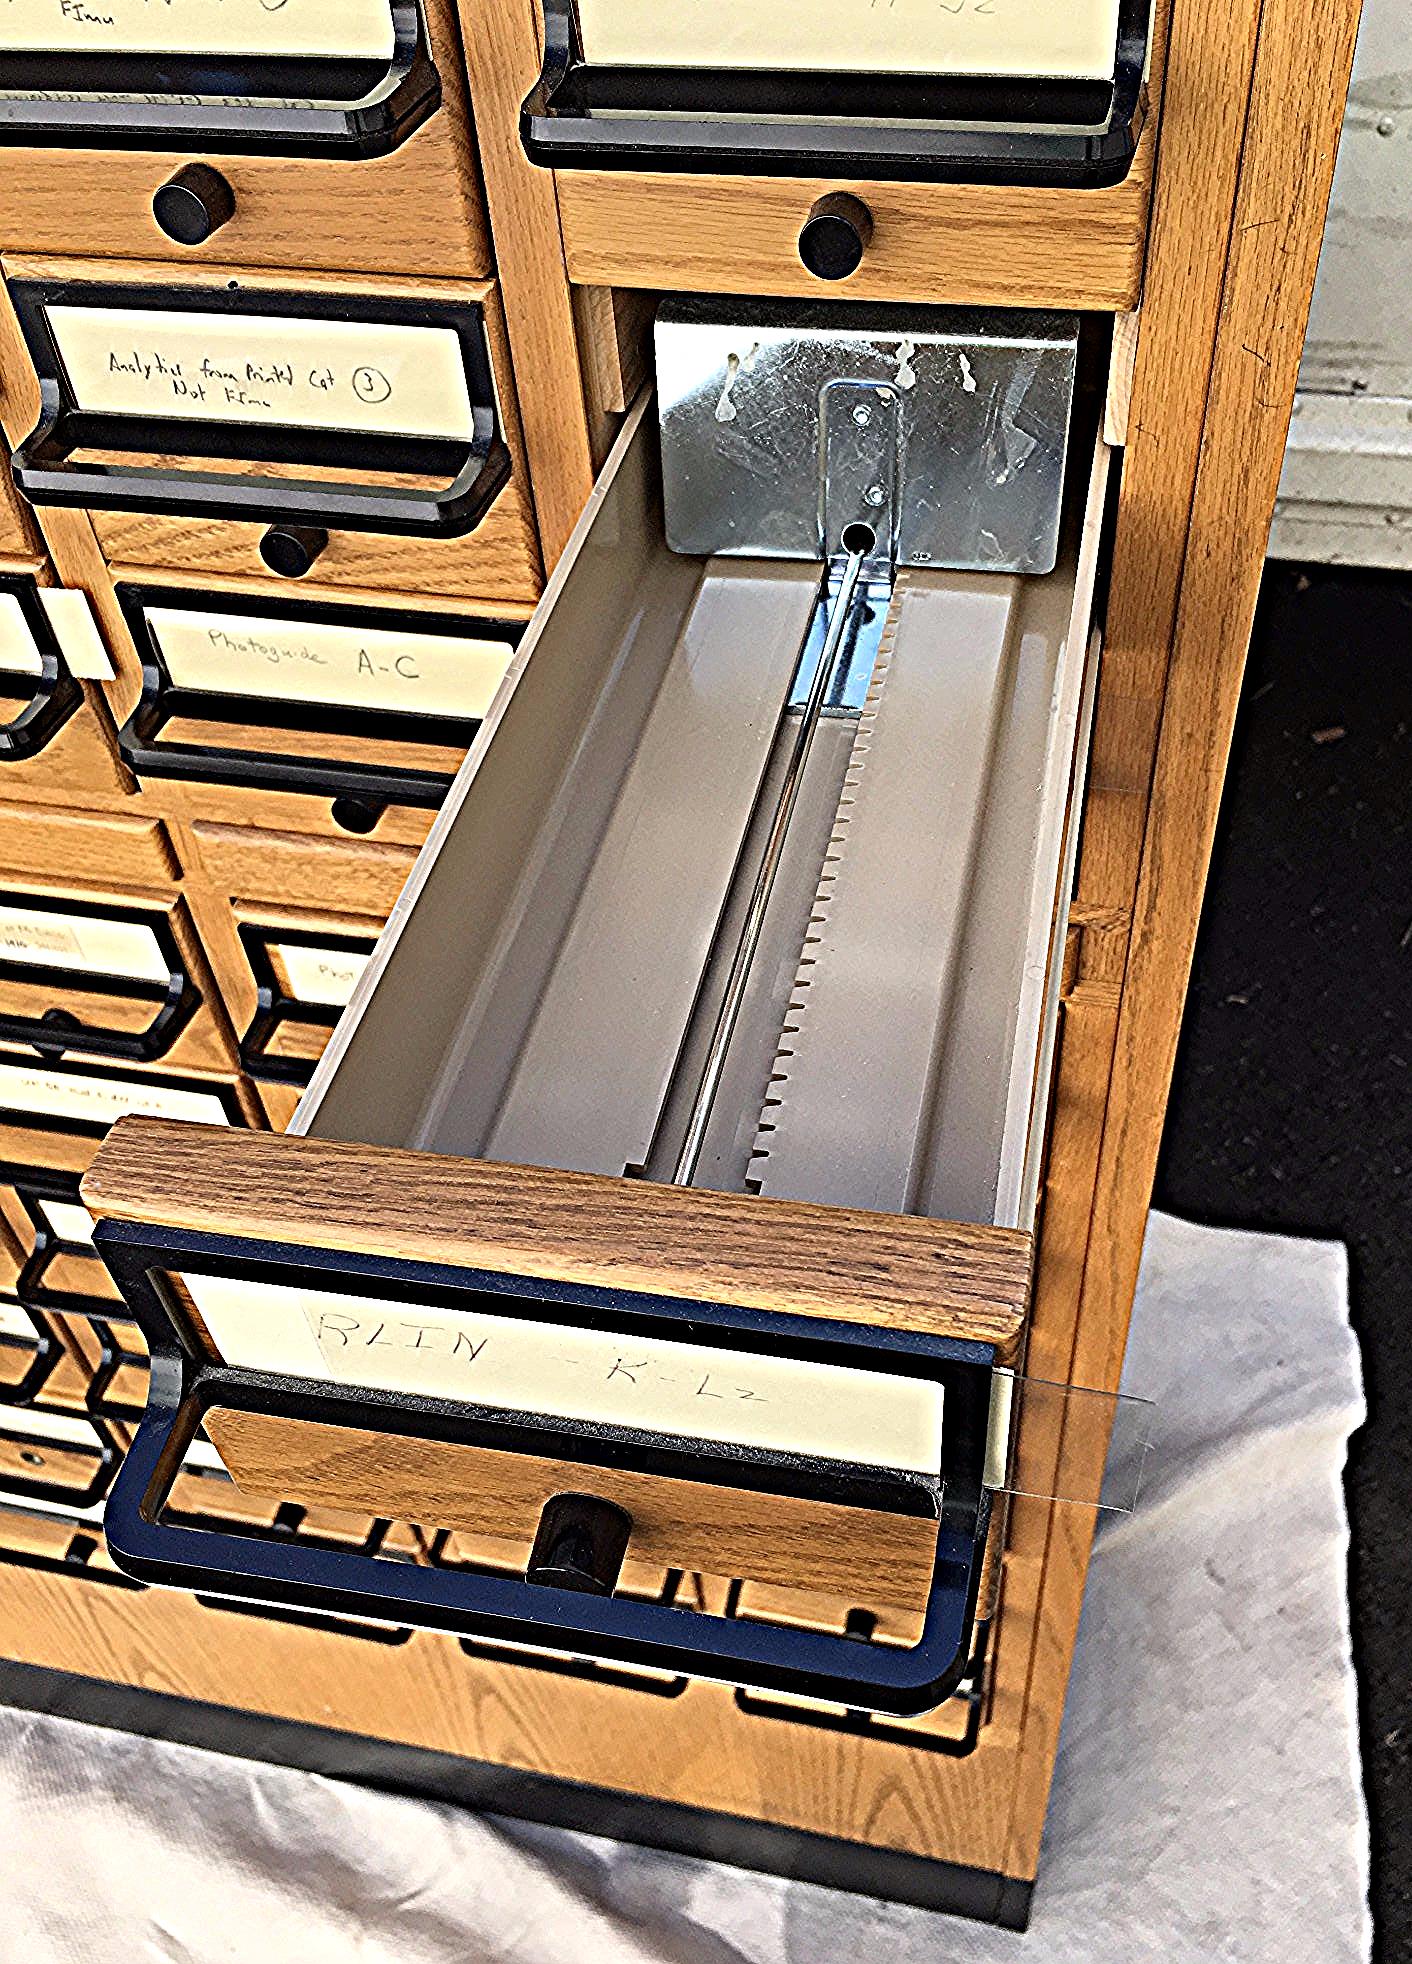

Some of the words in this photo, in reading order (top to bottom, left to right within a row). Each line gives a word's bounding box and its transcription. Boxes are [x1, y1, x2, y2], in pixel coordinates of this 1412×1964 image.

[199, 358, 239, 383] from
[172, 379, 206, 401] Not
[208, 628, 328, 663] Photoguide
[358, 648, 420, 679] A-C
[317, 1312, 488, 1362] RLIN
